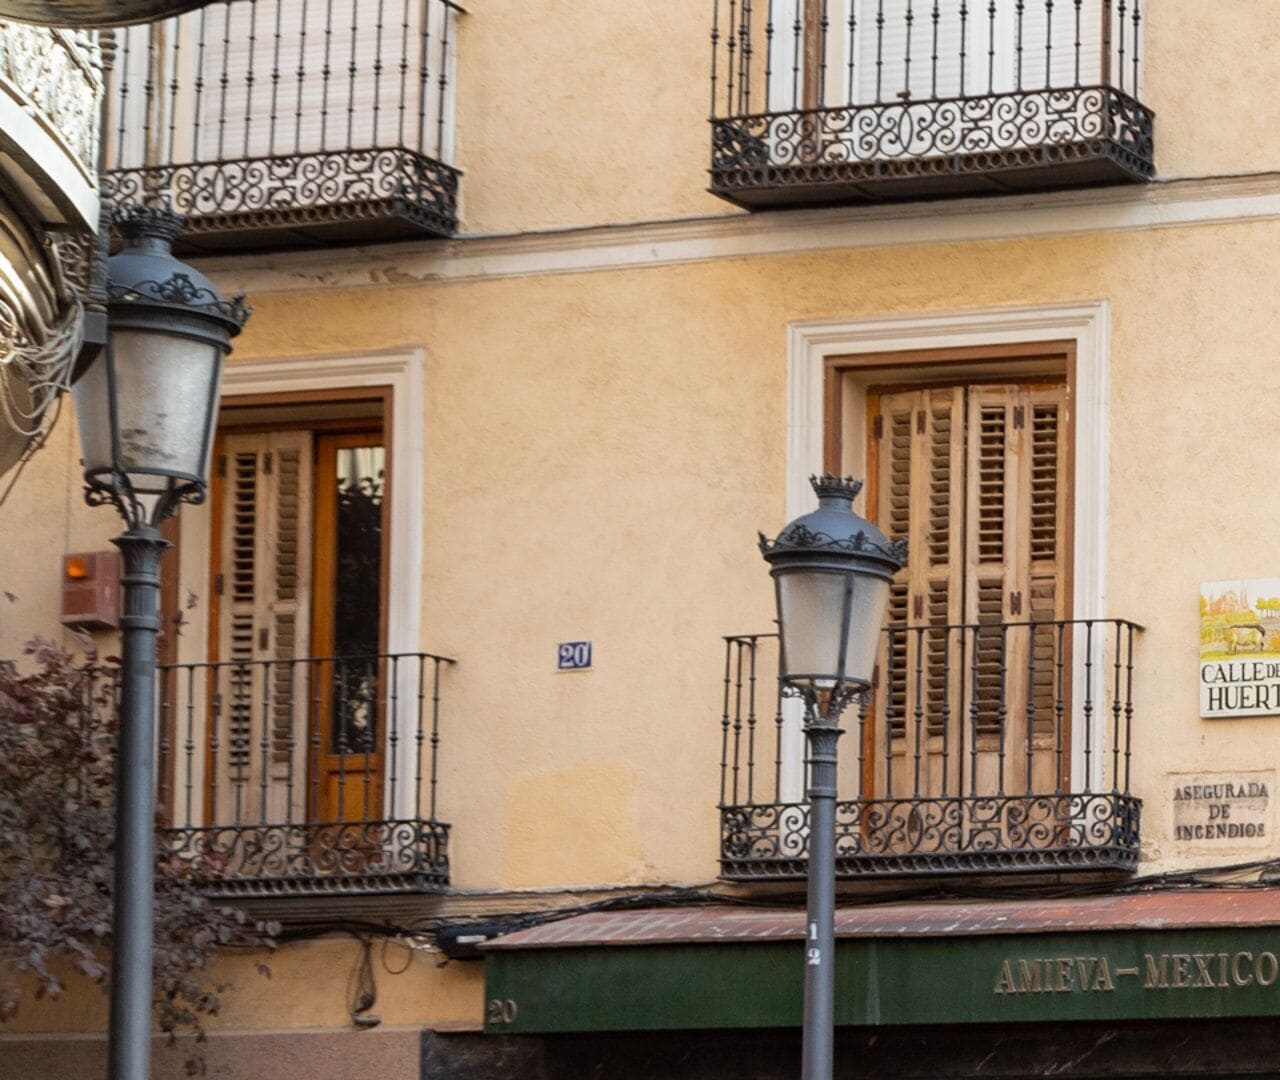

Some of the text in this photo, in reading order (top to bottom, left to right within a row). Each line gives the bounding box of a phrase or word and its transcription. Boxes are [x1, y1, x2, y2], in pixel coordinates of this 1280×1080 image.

[560, 644, 590, 667] 20
[1201, 661, 1264, 684] CALLE
[1174, 782, 1269, 800] ASEGURADA
[1208, 804, 1231, 820] DE
[1175, 823, 1266, 841] INCENDIOS
[489, 999, 518, 1024] 20
